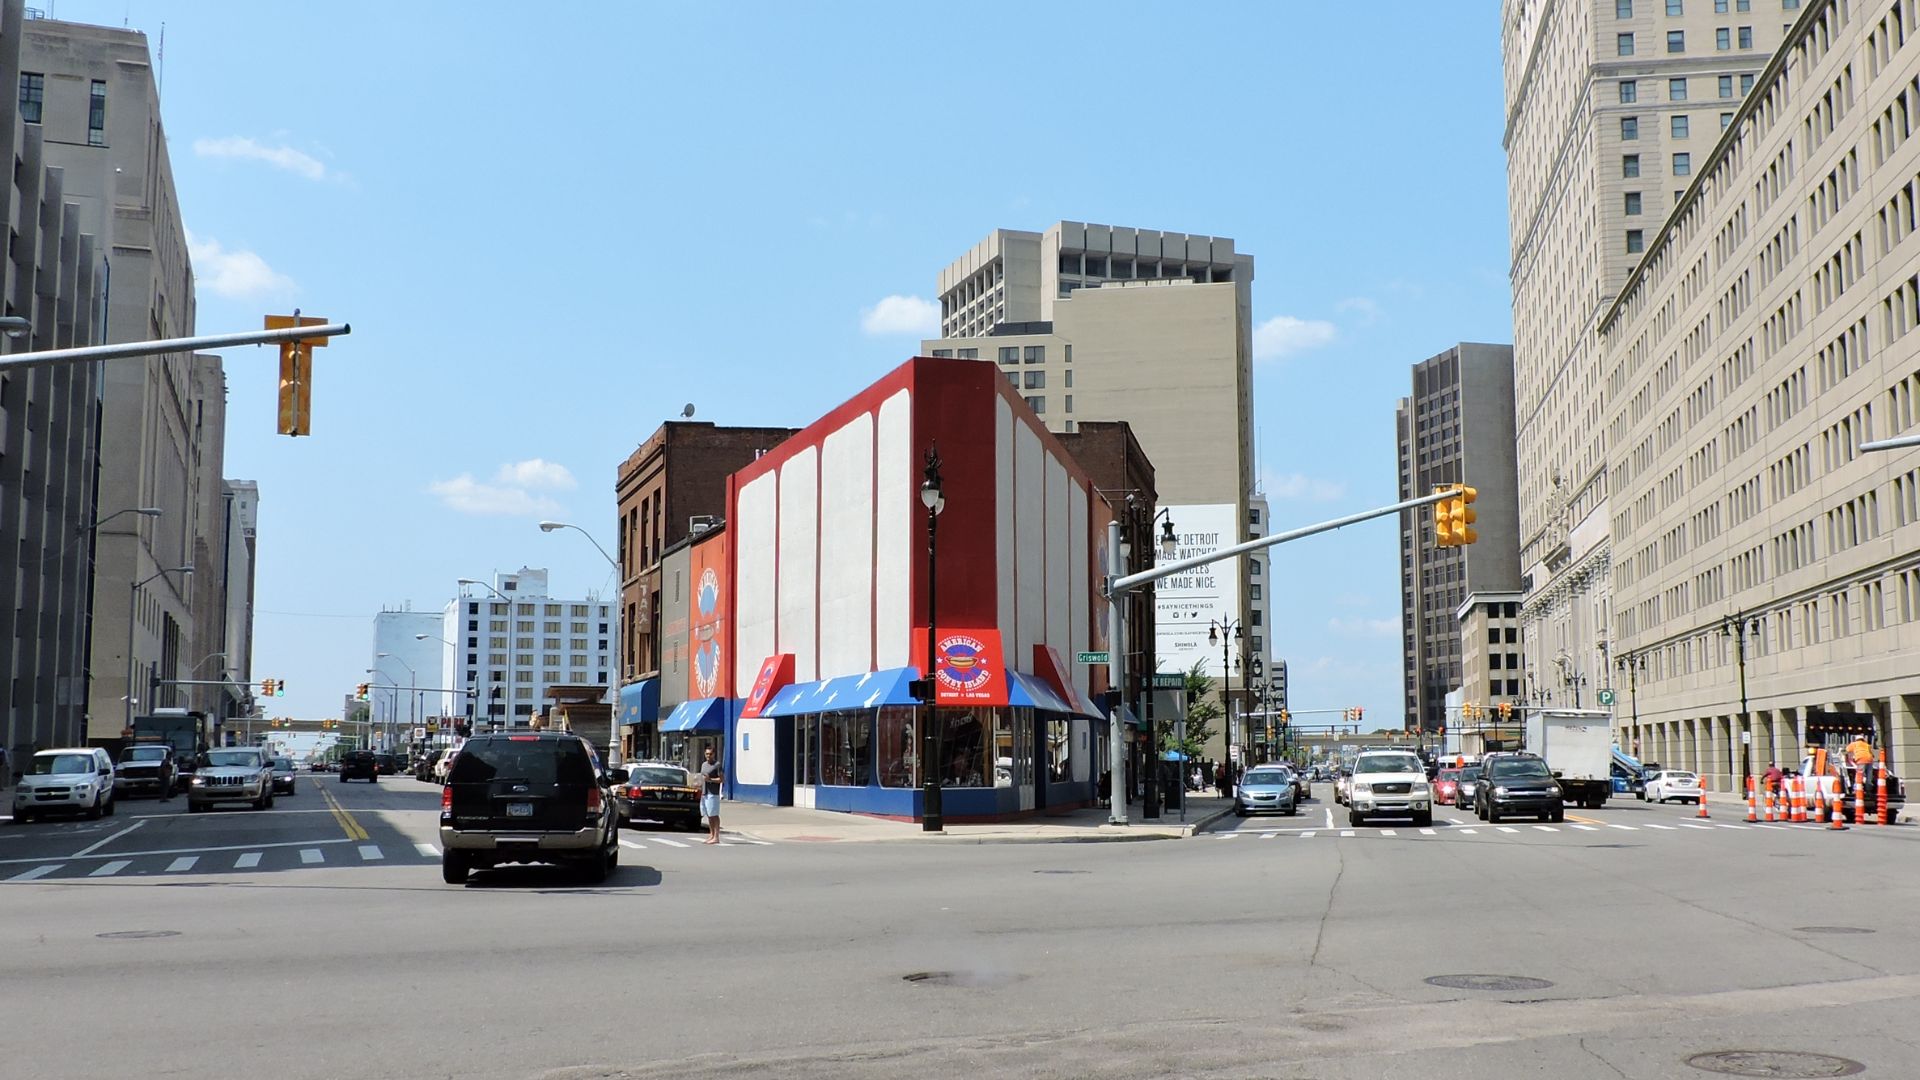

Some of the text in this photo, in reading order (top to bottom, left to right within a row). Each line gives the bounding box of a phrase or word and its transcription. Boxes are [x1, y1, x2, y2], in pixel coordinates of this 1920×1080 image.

[1184, 533, 1219, 546] DETROIT
[1156, 576, 1216, 589] WE MADE NICE.
[940, 638, 983, 653] AMERICAN
[1078, 653, 1108, 662] Griswold
[937, 669, 989, 689] CONEY ISLAND
[1602, 691, 1611, 703] P
